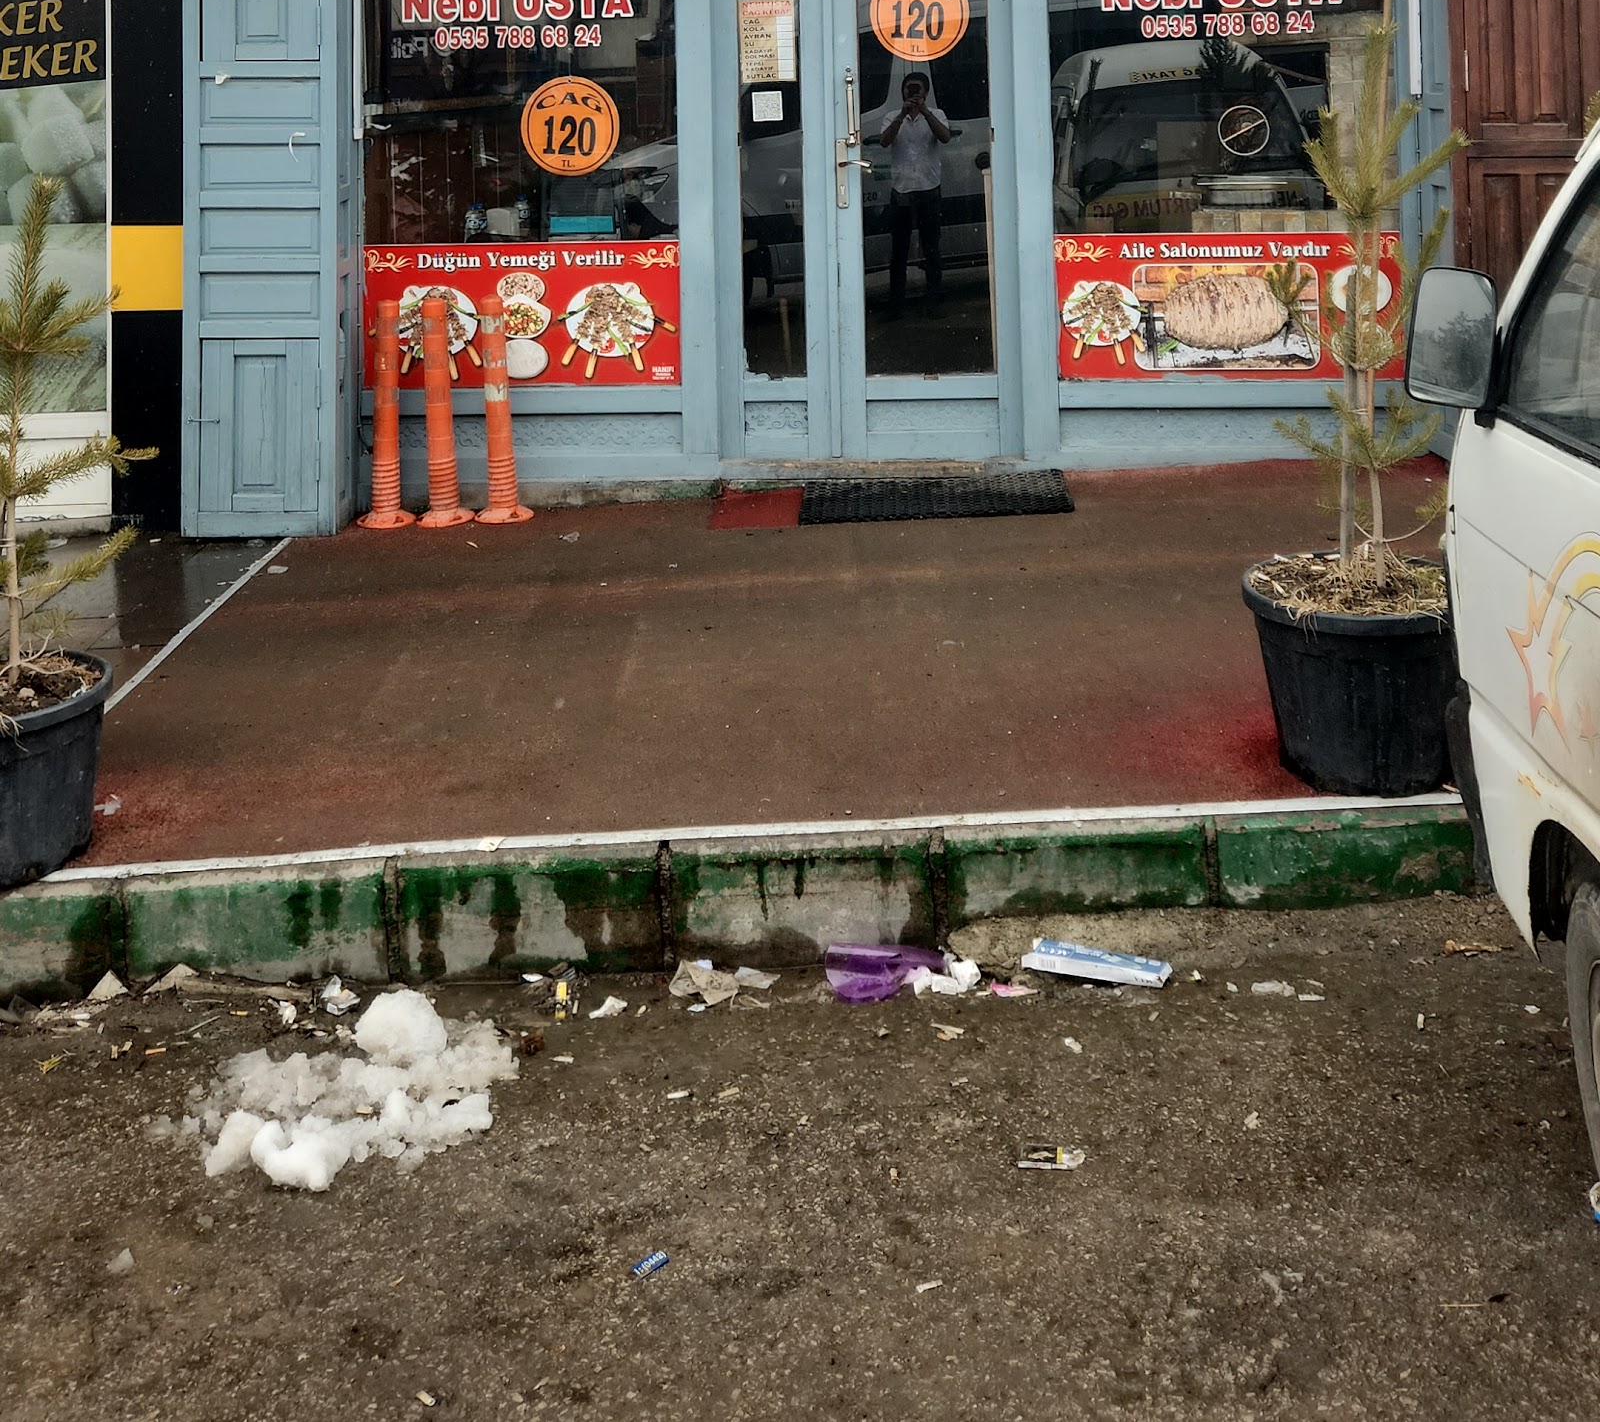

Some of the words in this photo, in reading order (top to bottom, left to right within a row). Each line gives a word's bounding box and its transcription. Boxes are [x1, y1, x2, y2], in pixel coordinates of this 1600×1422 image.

[891, 0, 944, 40] 120
[1141, 15, 1198, 38] 0535
[1203, 13, 1246, 37] 788
[1251, 12, 1280, 35] 68
[1286, 10, 1315, 34] 24
[435, 27, 489, 49] 0535
[495, 26, 535, 48] 788
[540, 25, 568, 47] 68
[574, 24, 602, 46] 24
[536, 92, 604, 114] CAĞ
[543, 115, 597, 157] 120
[417, 252, 481, 272] Düğün
[487, 250, 557, 271] Yemeği
[562, 249, 625, 266] Verilir
[1119, 242, 1155, 258] Aile
[1159, 242, 1263, 258] Salonumuz
[1268, 240, 1331, 257] Vardır
